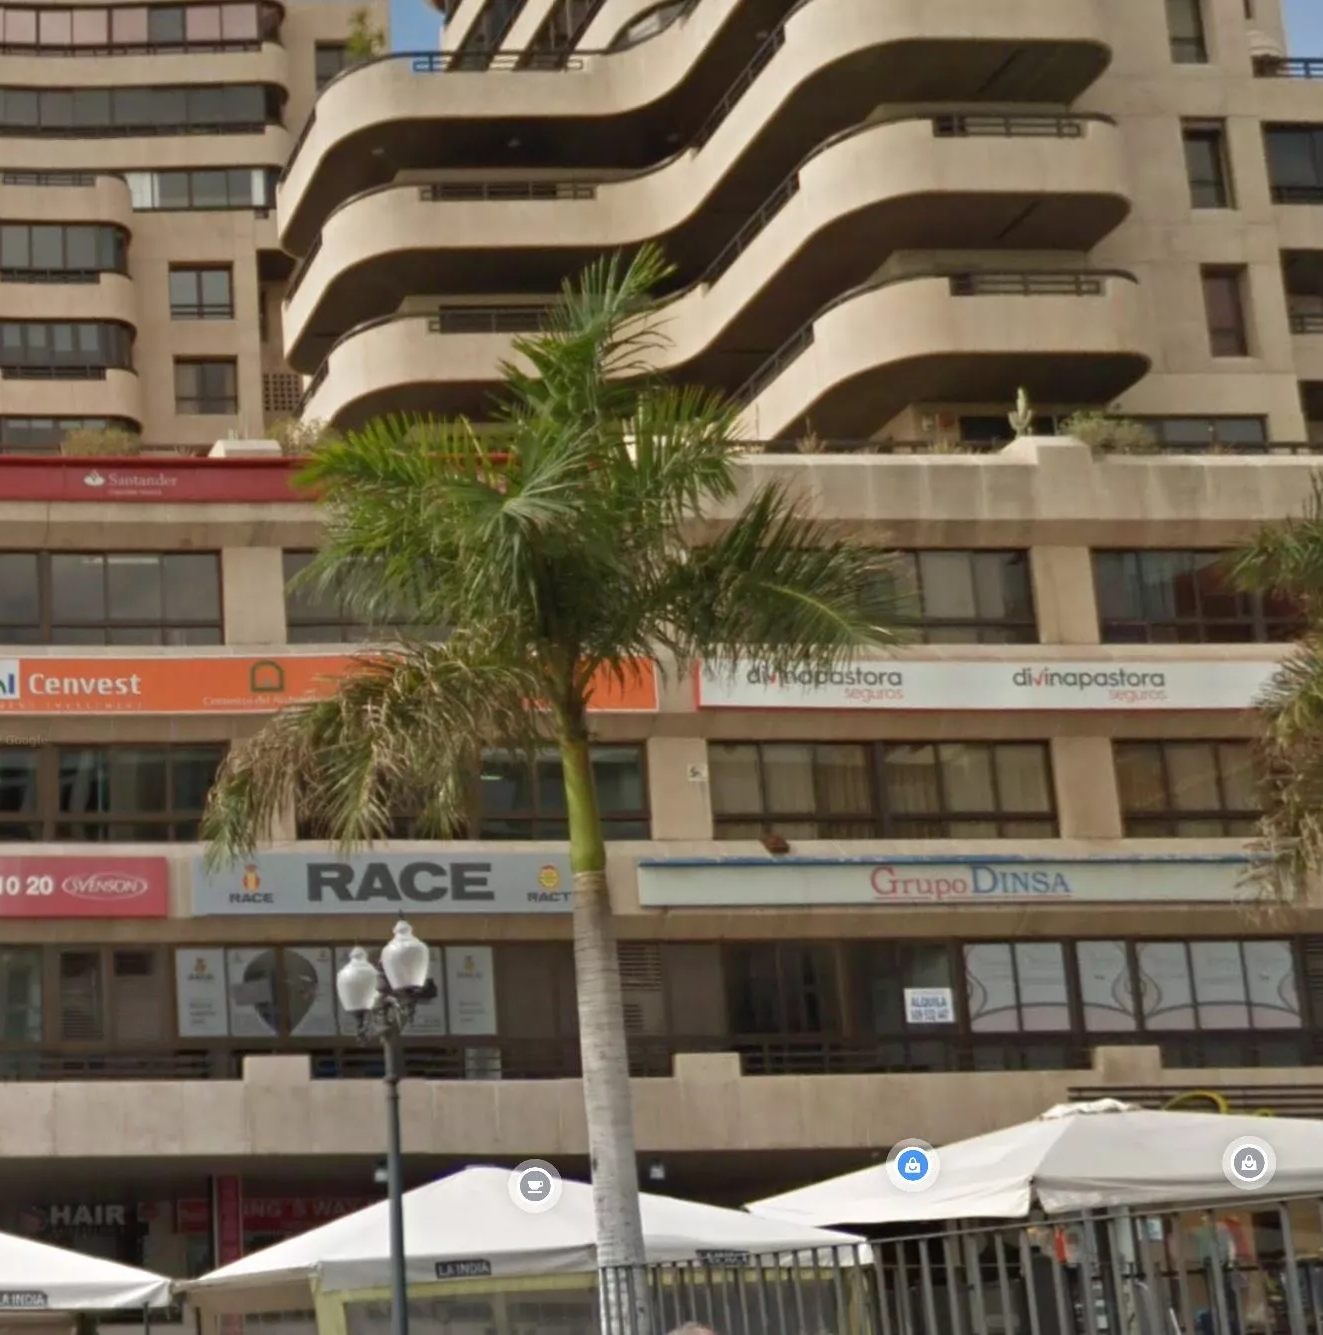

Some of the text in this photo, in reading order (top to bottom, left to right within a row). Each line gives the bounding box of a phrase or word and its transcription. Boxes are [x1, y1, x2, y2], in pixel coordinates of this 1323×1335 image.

[108, 471, 178, 487] Santander
[27, 673, 142, 696] Cenvest
[1012, 667, 1166, 690] divinapastora
[844, 687, 905, 703] seguros
[1108, 689, 1168, 703] seguros
[25, 876, 54, 896] 20
[71, 874, 138, 893] SVENSON
[305, 861, 496, 903] RACE
[228, 892, 274, 904] RACE
[526, 891, 572, 903] RACT
[49, 1204, 126, 1226] HAIR
[11, 1292, 45, 1305] INDIA
